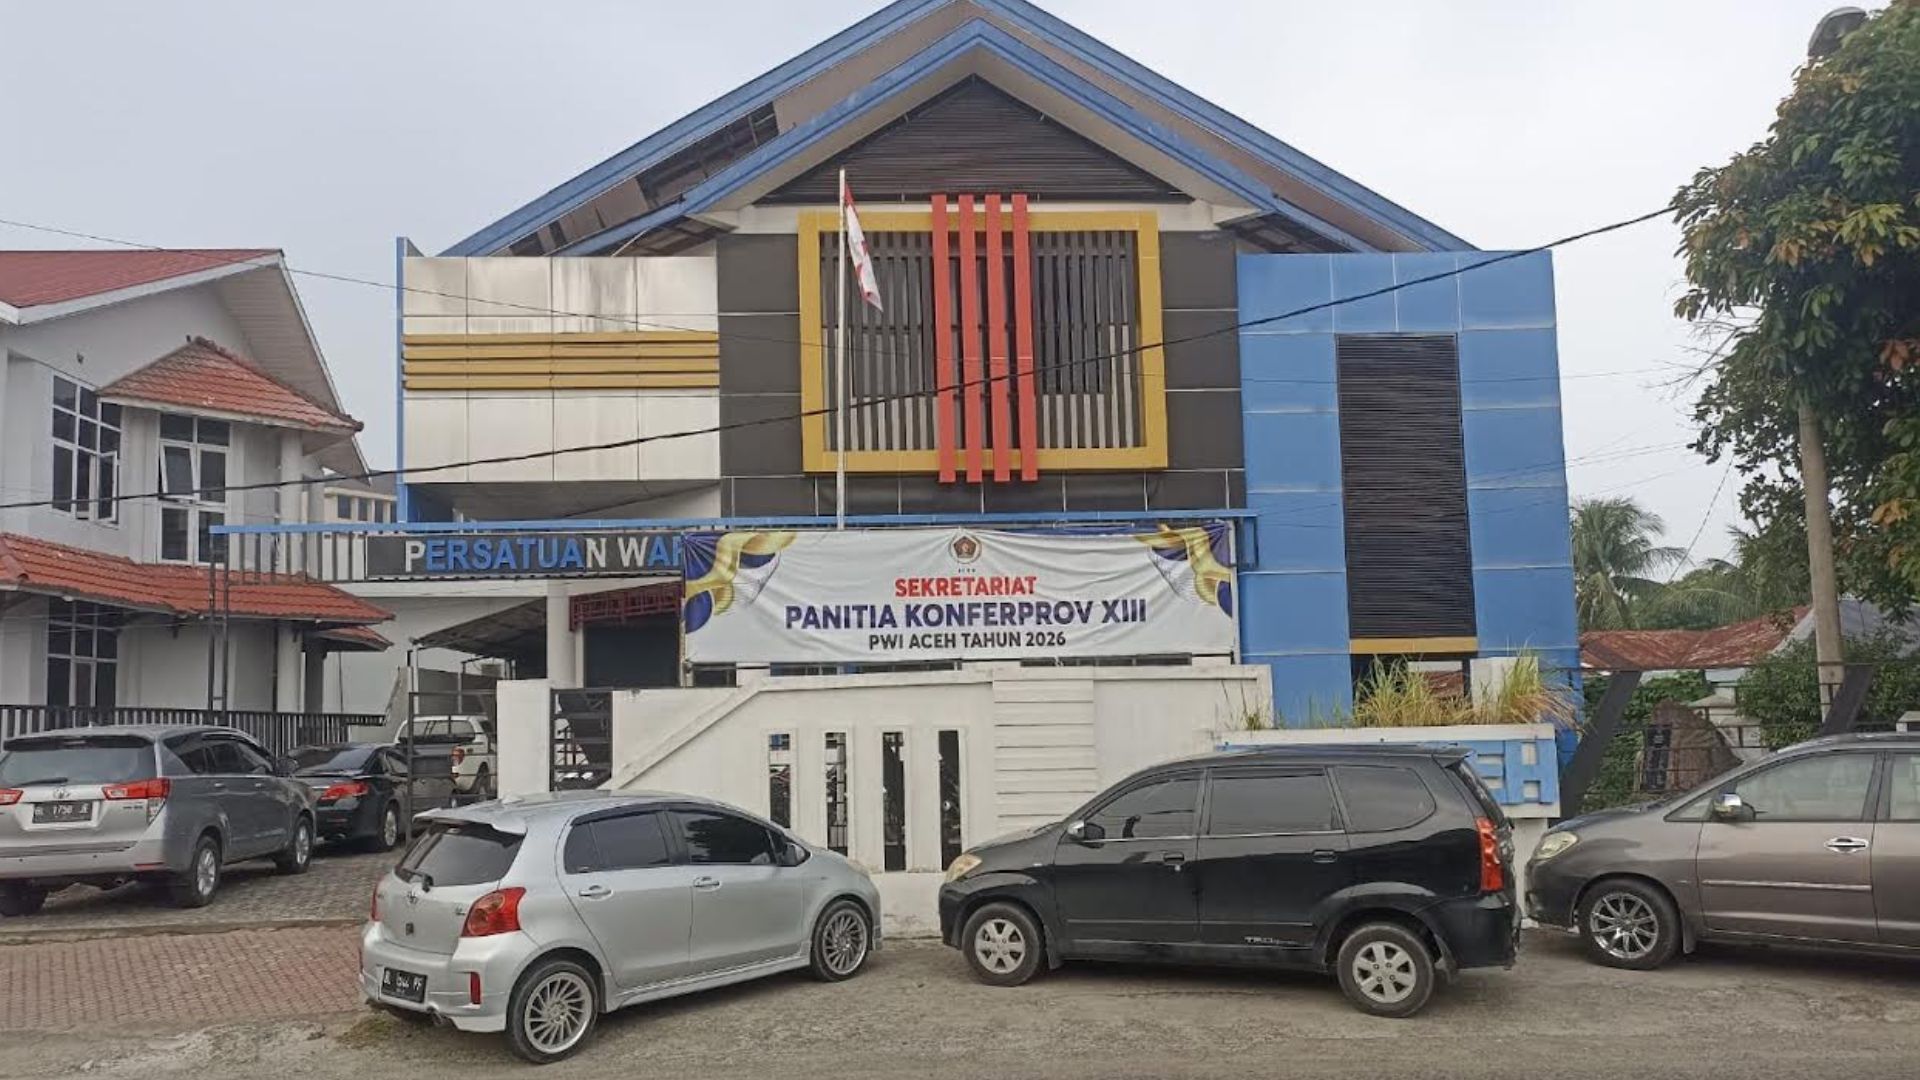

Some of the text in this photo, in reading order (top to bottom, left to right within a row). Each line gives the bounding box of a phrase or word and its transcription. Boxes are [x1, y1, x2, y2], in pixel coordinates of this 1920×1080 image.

[405, 536, 607, 572] PERSATUAN
[895, 576, 1038, 598] SEKRETARIAT
[785, 599, 1147, 629] PANITIA KONFERPROV XIII
[869, 631, 1067, 650] PWI ACEH TAHUN 2026
